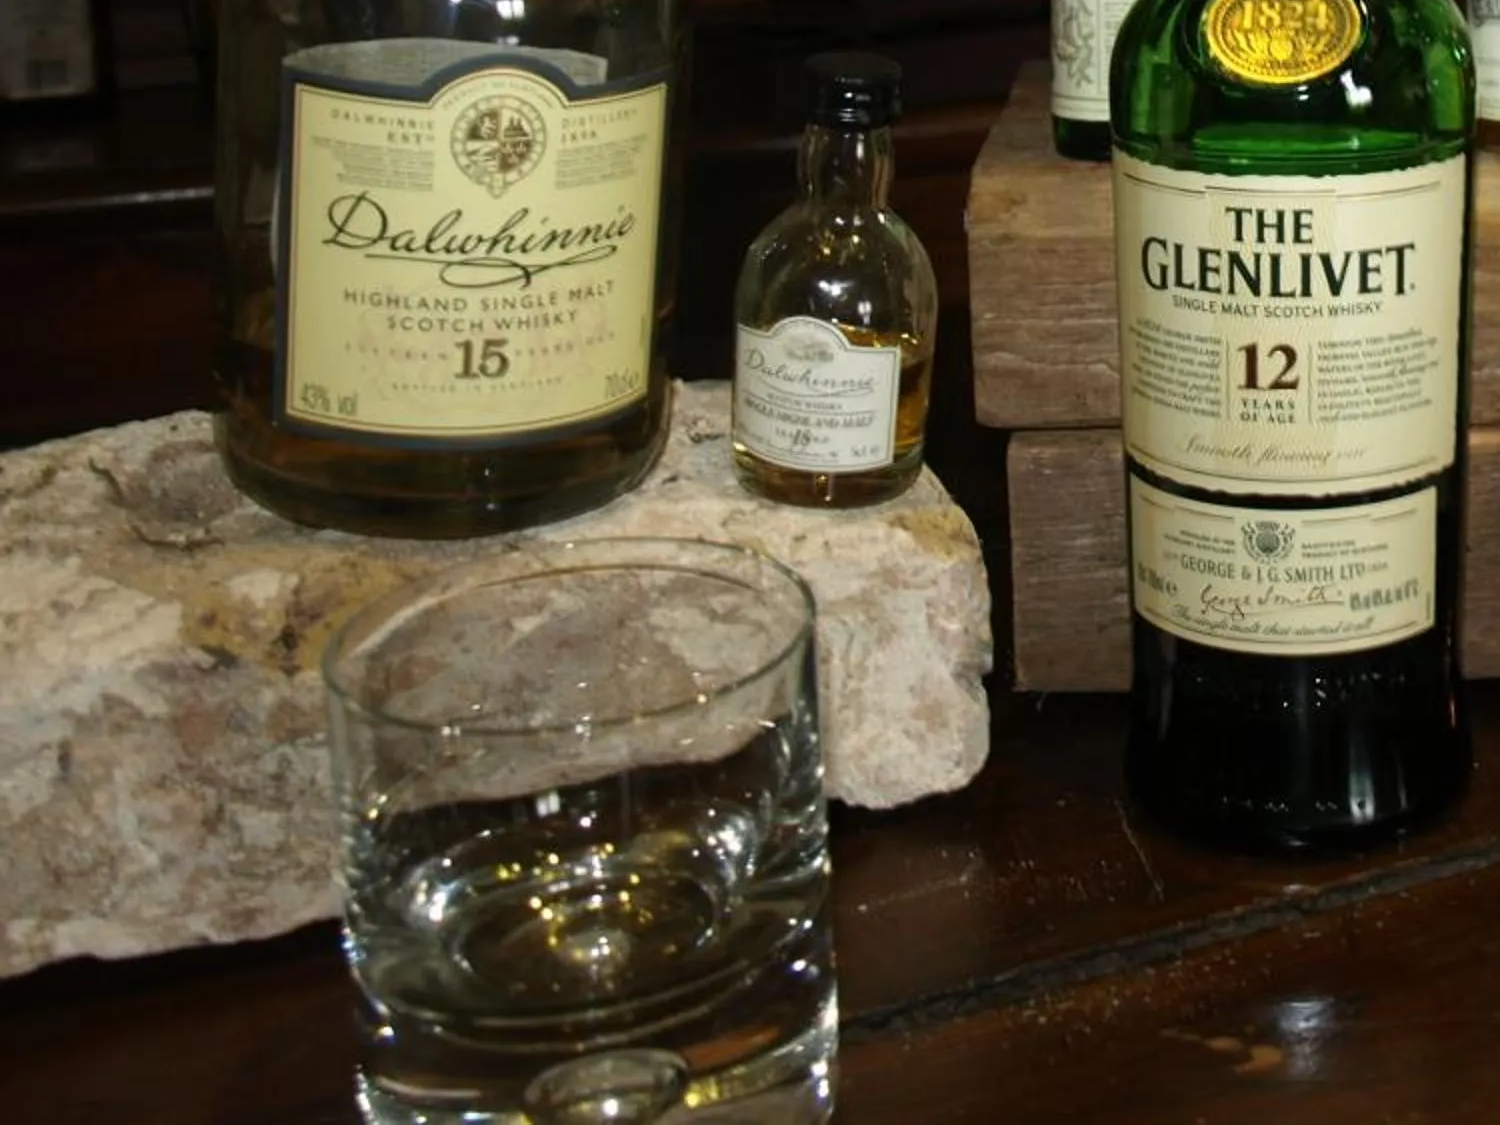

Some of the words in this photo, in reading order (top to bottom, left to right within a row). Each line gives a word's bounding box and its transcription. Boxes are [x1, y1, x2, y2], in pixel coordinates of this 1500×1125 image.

[1243, 0, 1328, 30] 1824
[322, 191, 636, 256] Dalwhinnie
[1225, 206, 1315, 245] THE
[1140, 236, 1415, 299] GLENLIVET
[343, 287, 468, 314] HIGHLAND
[480, 290, 559, 314] SINGLE
[567, 280, 616, 305] MALT
[1171, 294, 1217, 315] SINGLE
[1220, 300, 1260, 318] MALT
[1263, 302, 1324, 319] SCOTCH
[1327, 301, 1383, 317] WHISKY
[386, 315, 484, 333] SCOTCH
[493, 309, 580, 332] WHISKY
[452, 338, 511, 381] 15
[743, 347, 875, 388] Dalwhinnie
[1236, 341, 1300, 393] 12
[1239, 411, 1259, 424] OF
[1266, 412, 1297, 425] AGE
[1240, 398, 1297, 411] YEARS
[1181, 554, 1236, 580] GEORGE
[1241, 564, 1253, 581] &
[1284, 563, 1335, 584] SMITH
[1340, 561, 1366, 581] LTD
